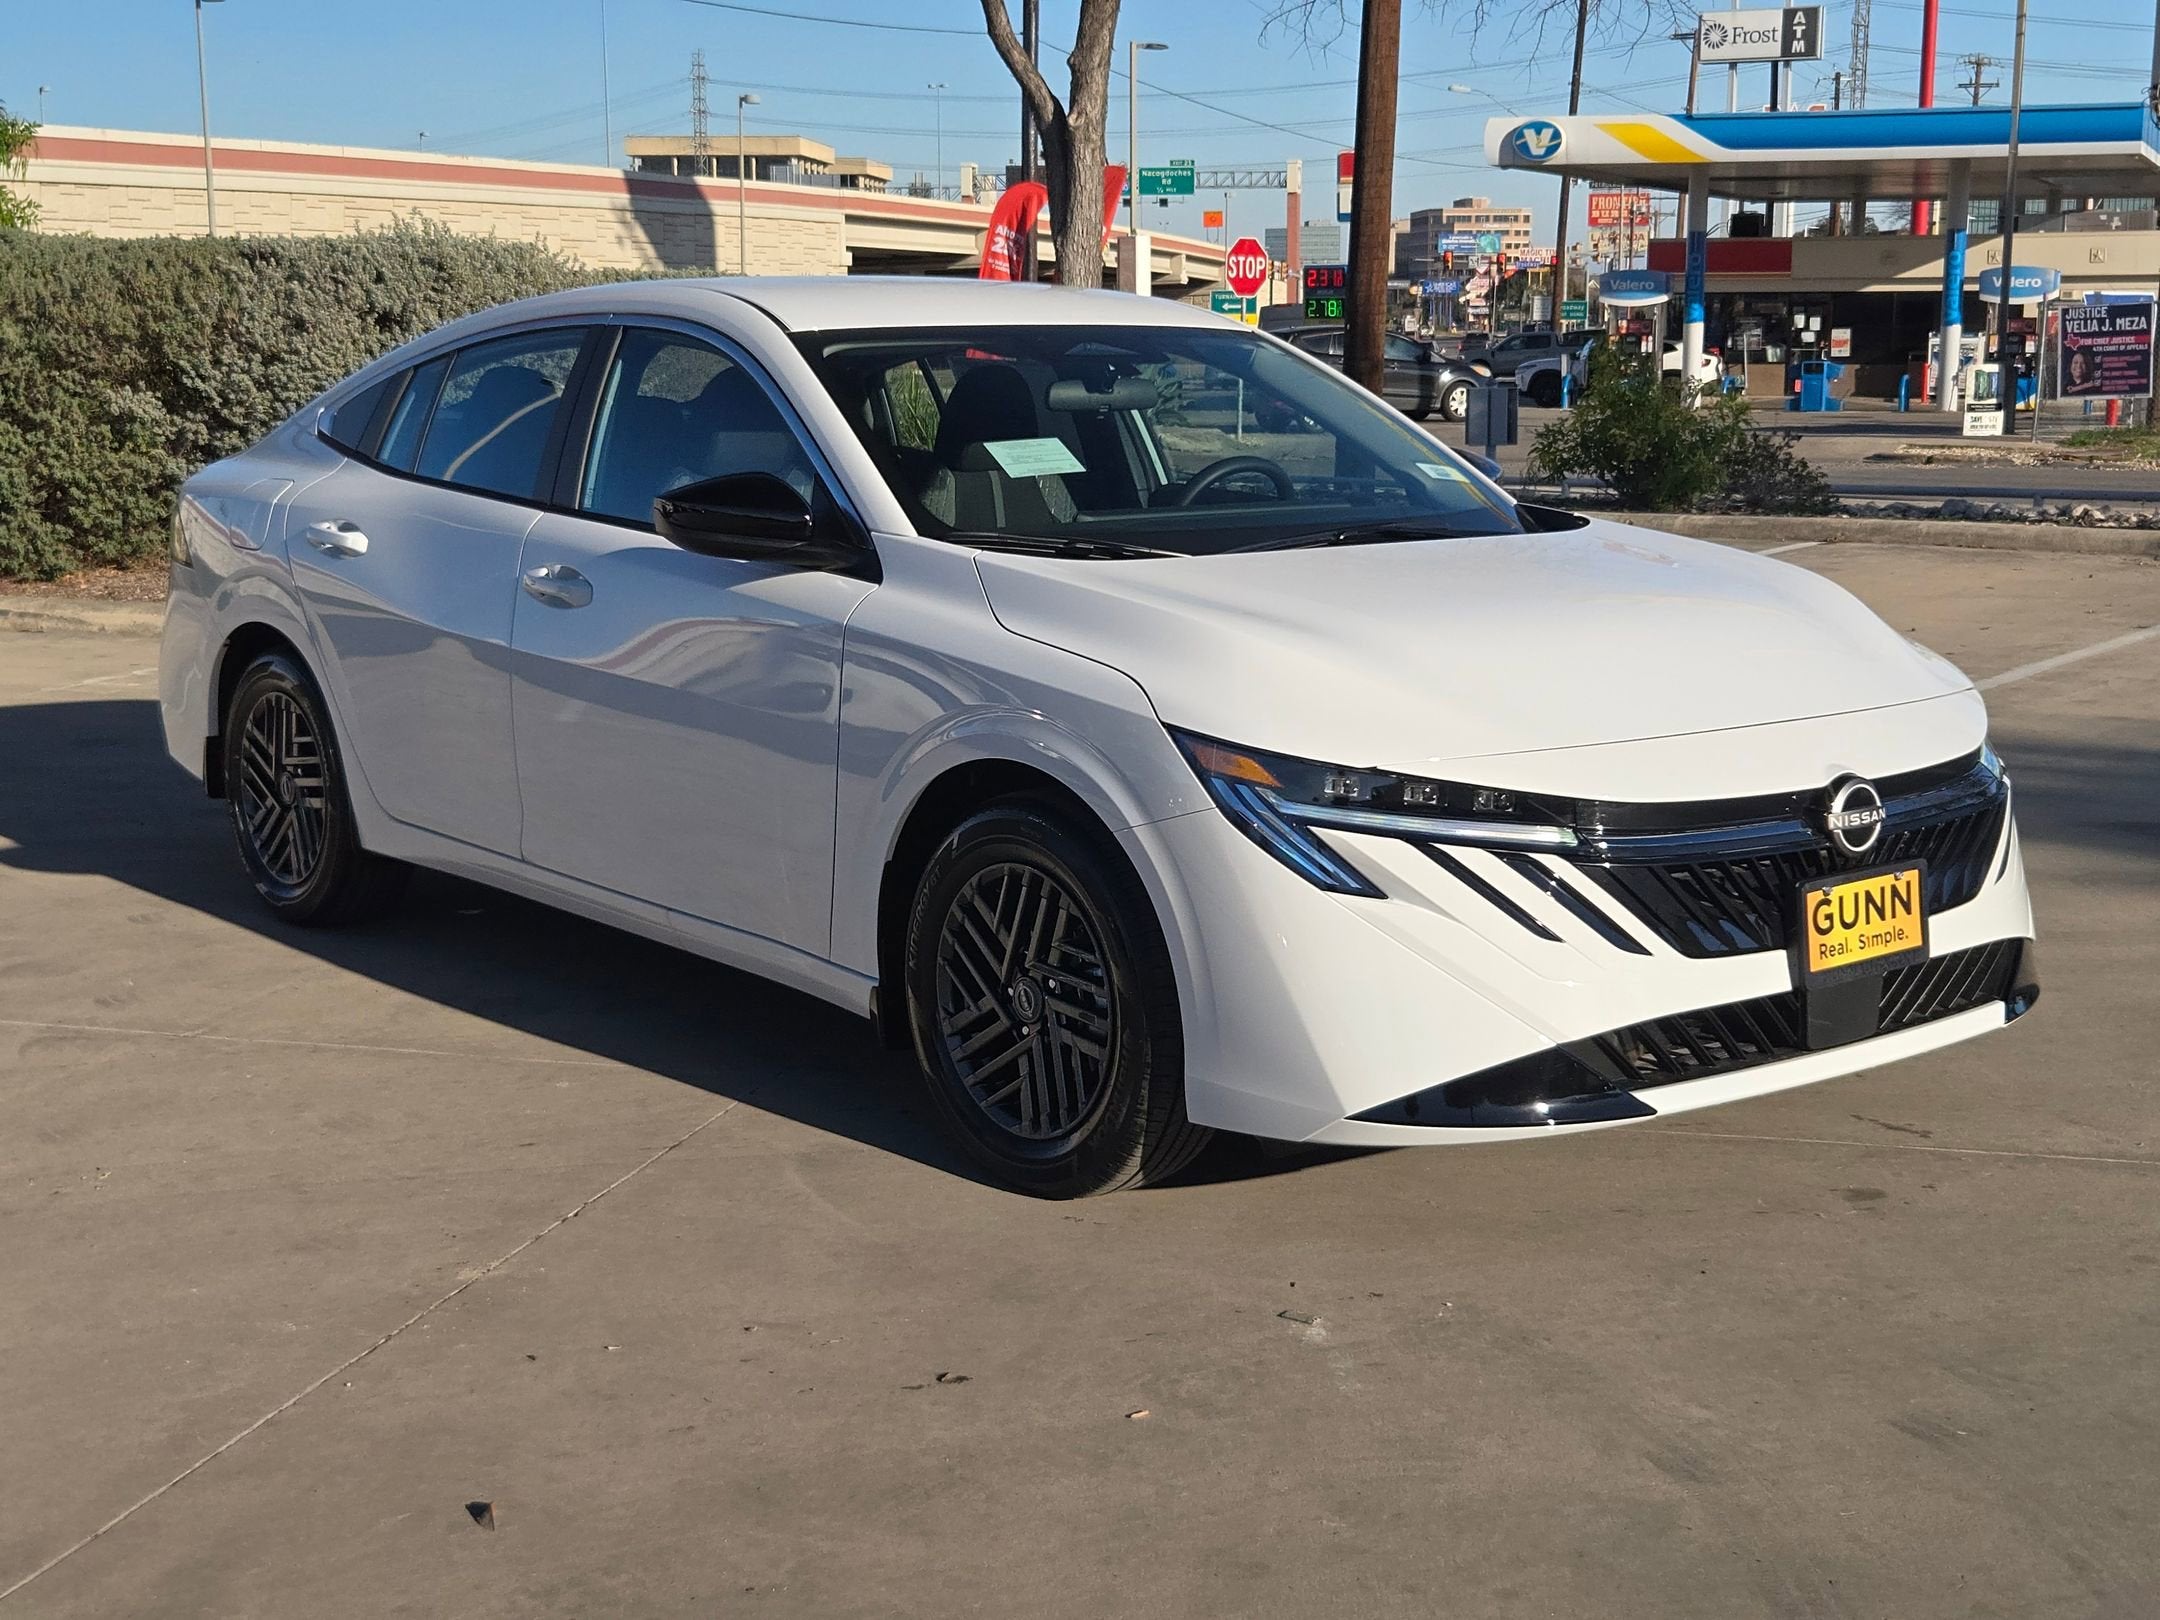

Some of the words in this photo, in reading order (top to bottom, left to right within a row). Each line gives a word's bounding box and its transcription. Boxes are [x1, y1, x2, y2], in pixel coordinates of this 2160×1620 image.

[1732, 26, 1778, 45] Frost
[1791, 11, 1806, 53] ATM
[1141, 170, 1191, 178] Nacogdoches
[1519, 248, 1543, 257] MAGIC
[1228, 256, 1265, 279] STOP
[1610, 279, 1654, 290] Valero
[1992, 276, 2042, 288] Vlero
[1308, 300, 1337, 318] 2.78
[2065, 307, 2108, 320] JUSTICE
[2065, 319, 2099, 333] VELIA
[2101, 319, 2113, 331] J.
[2115, 316, 2148, 331] MEZA
[2092, 337, 2109, 345] CHIEF
[2110, 336, 2136, 344] JUSTICE
[2126, 343, 2148, 351] APPEALS
[1829, 808, 1886, 829] NISSAN
[1812, 880, 1912, 936] GUNN
[1819, 937, 1853, 960] Real.
[1858, 925, 1909, 951] Simple.
